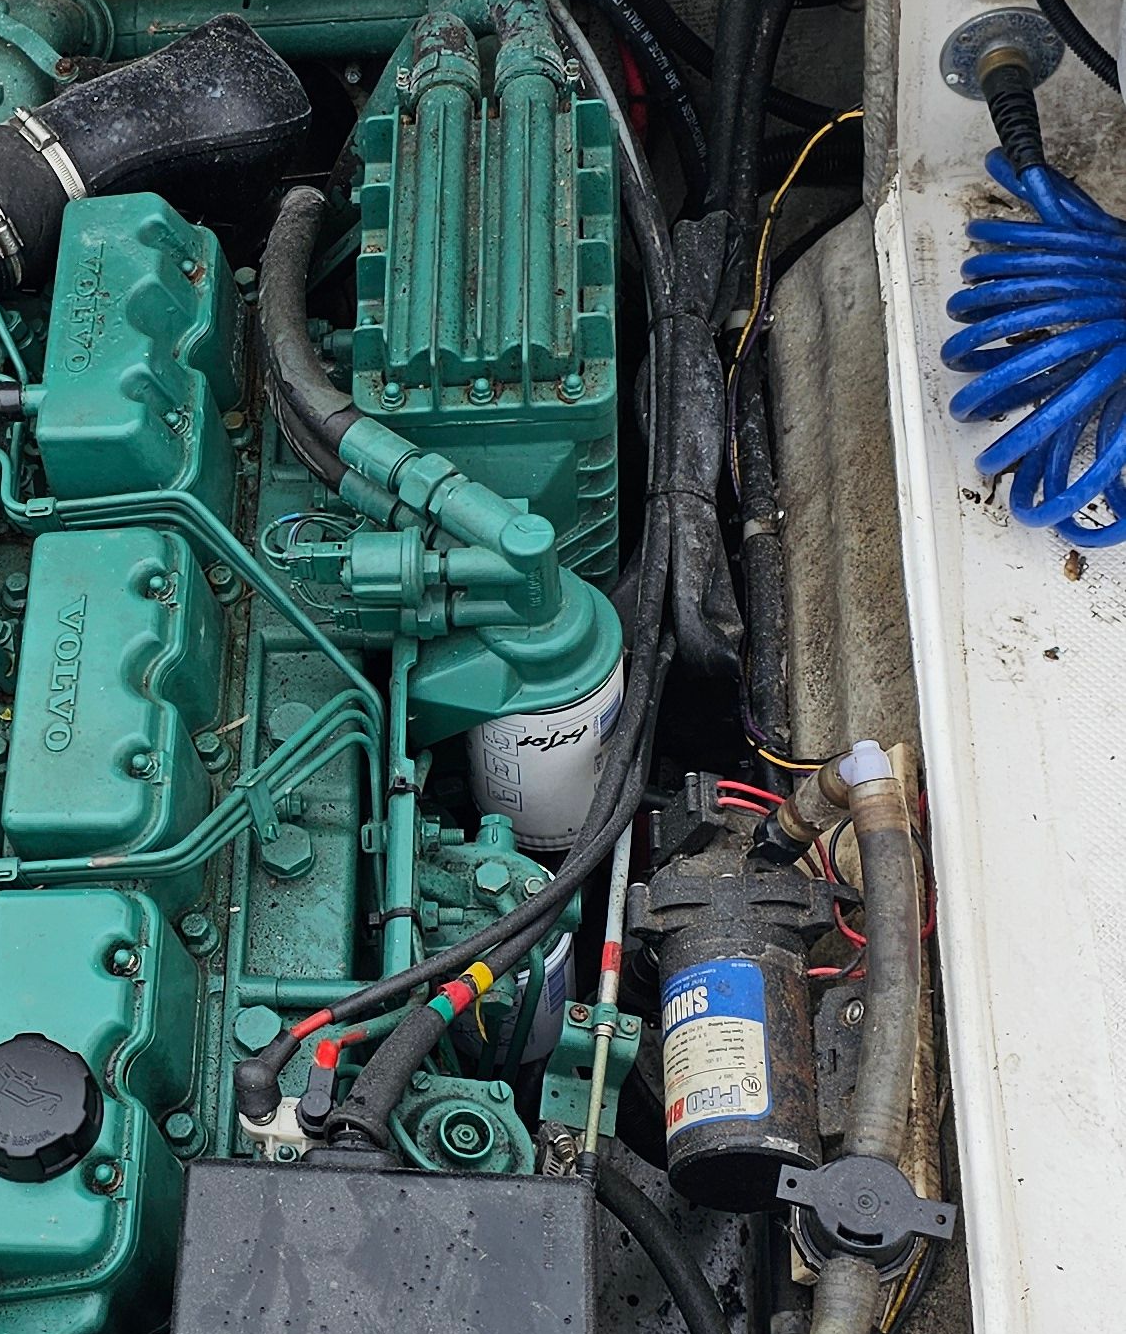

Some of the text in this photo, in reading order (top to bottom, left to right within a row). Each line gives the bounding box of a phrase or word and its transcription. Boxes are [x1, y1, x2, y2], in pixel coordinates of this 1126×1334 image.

[622, 7, 646, 34] ITALY
[639, 30, 654, 44] IN
[648, 41, 670, 71] MADE
[65, 240, 107, 373] VOLVO
[44, 593, 88, 753] VOLVO
[687, 1085, 741, 1114] PRO
